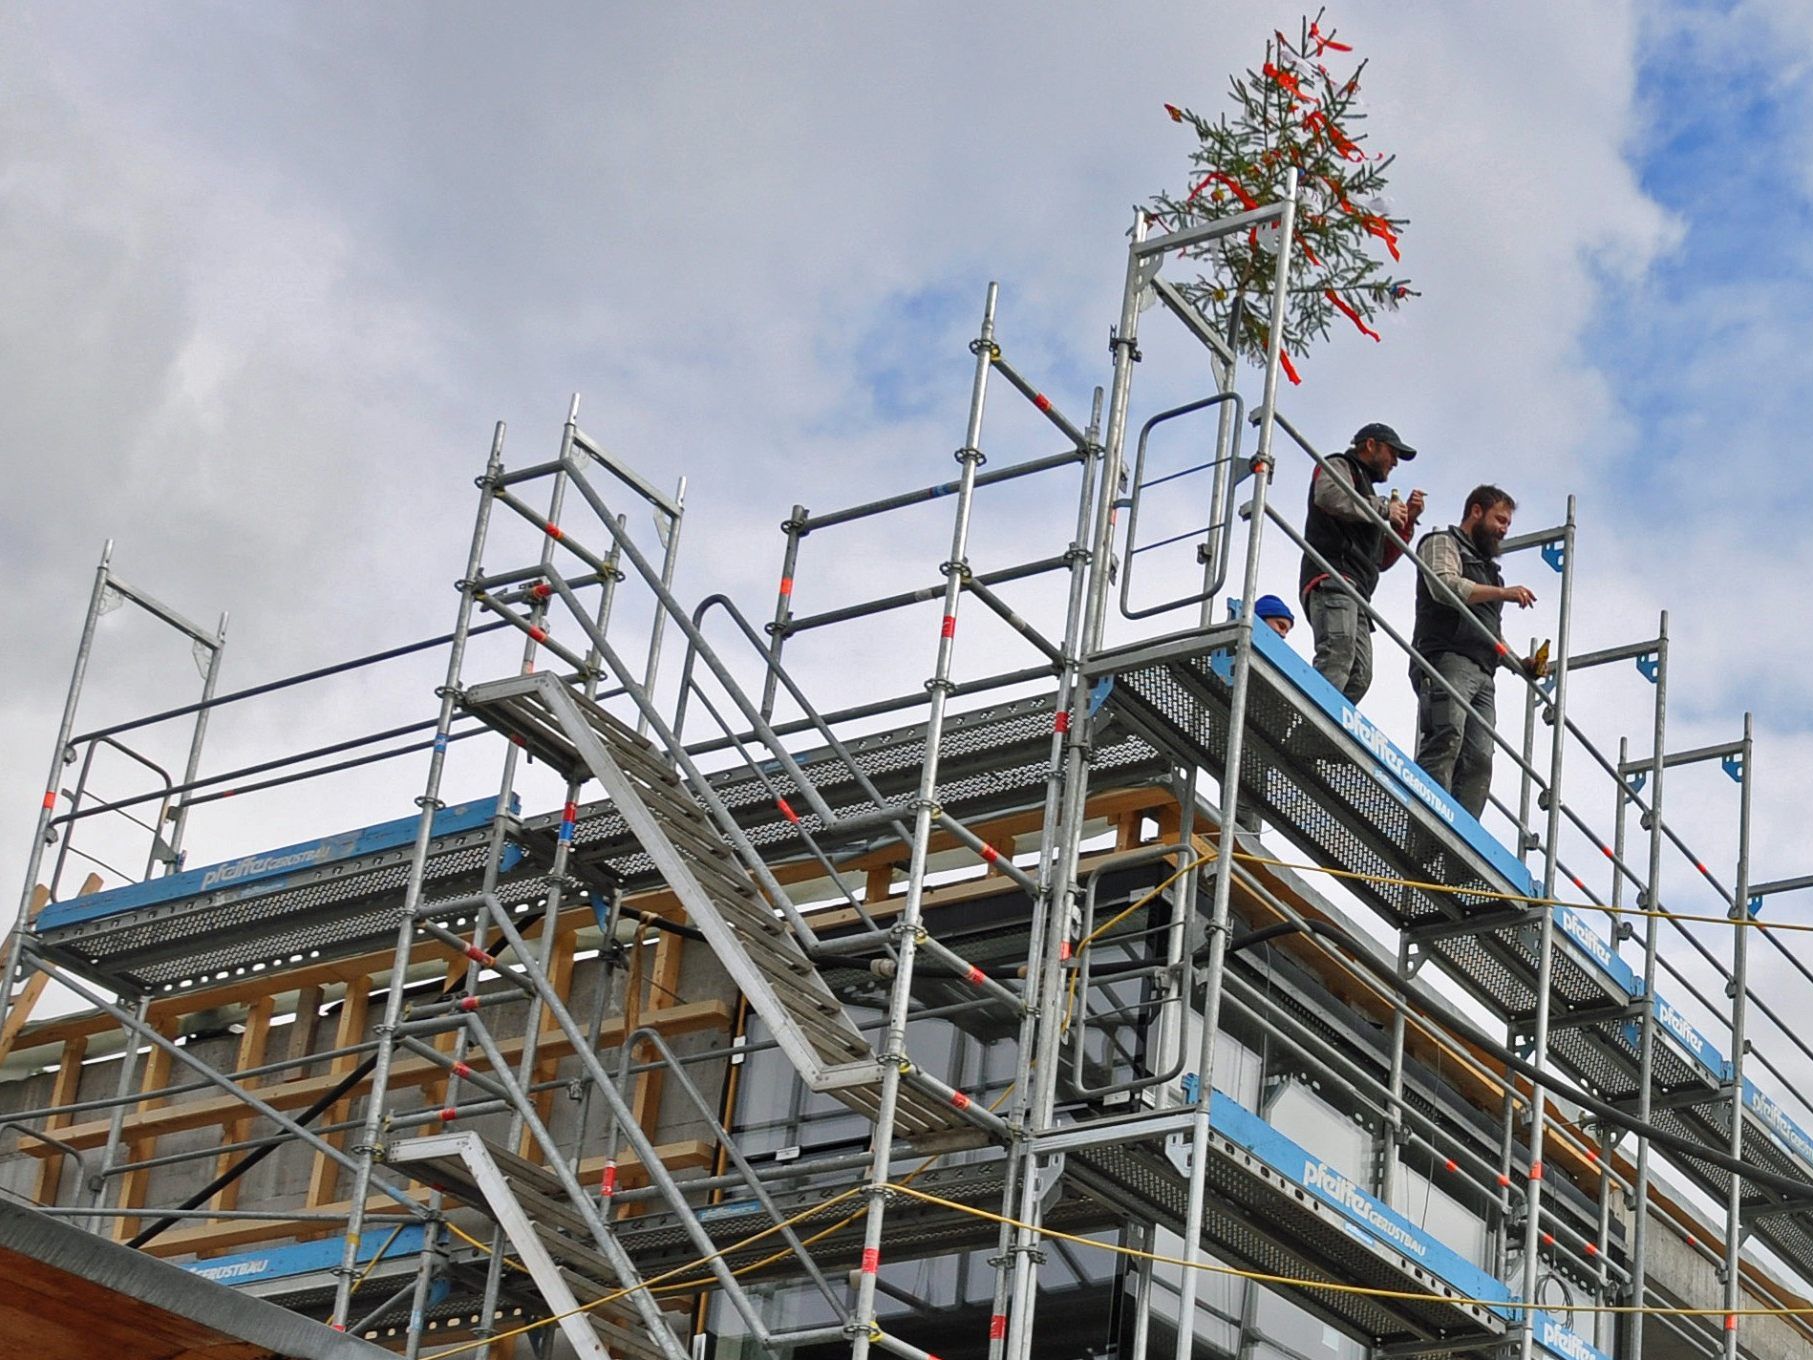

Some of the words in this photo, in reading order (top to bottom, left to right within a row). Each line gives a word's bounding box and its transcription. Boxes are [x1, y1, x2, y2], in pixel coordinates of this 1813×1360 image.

[1342, 705, 1404, 776] pfeiffer
[201, 856, 273, 890] pfeiffer
[1562, 913, 1612, 967] pfeiffer
[1660, 1004, 1703, 1053] pfeiffer
[1753, 1092, 1793, 1140] pfeiffer
[1303, 1159, 1372, 1219] pfeiffer
